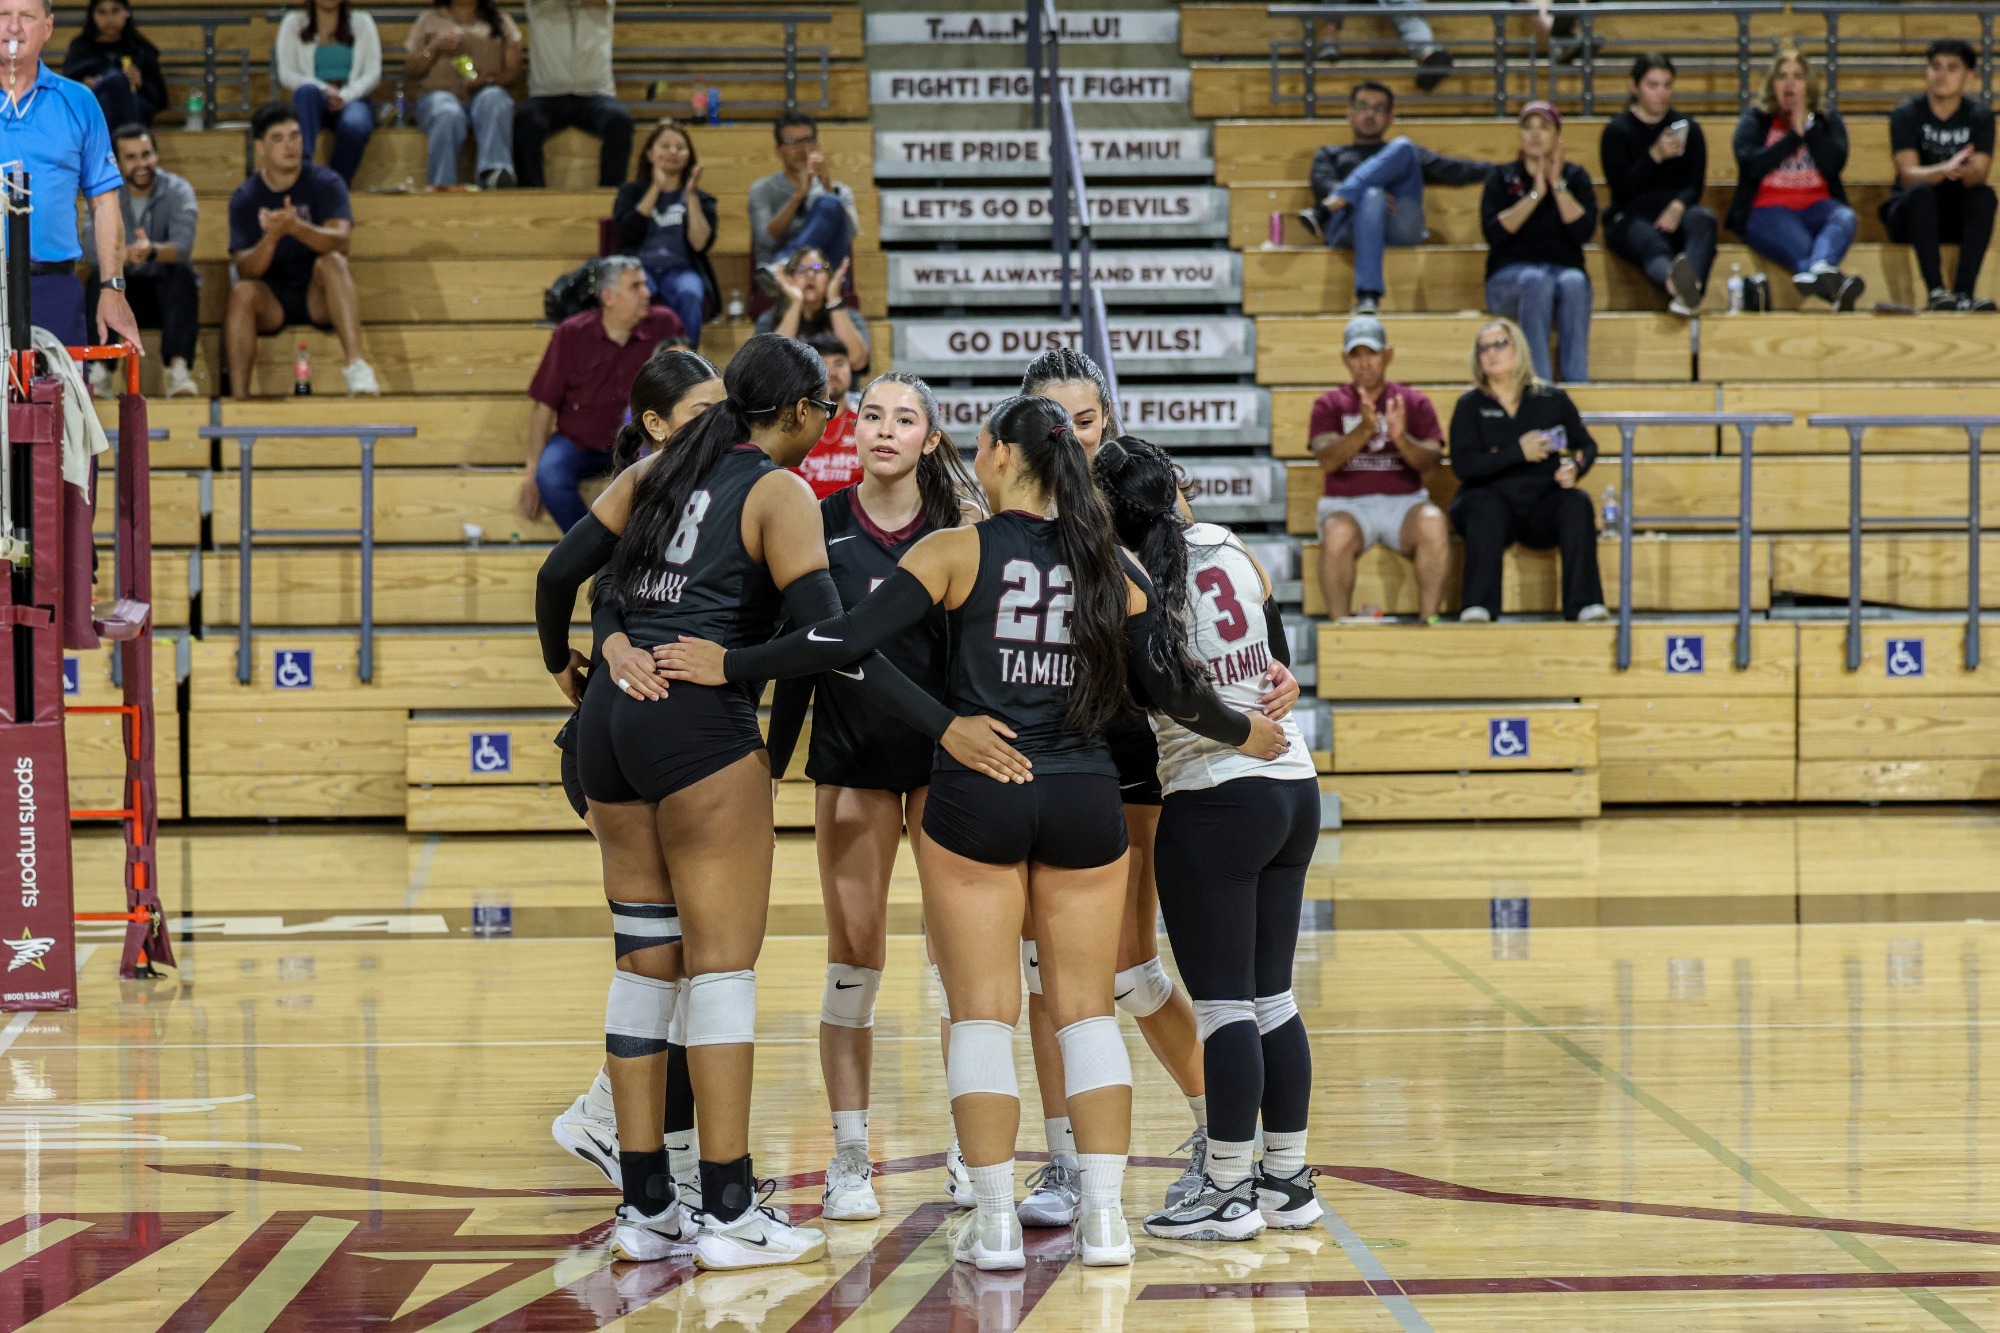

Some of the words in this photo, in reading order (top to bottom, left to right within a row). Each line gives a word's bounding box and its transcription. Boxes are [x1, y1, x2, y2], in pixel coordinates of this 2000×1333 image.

[892, 77, 979, 98] FIGHT!
[1083, 75, 1171, 96] FIGHT!
[903, 142, 955, 161] THE
[962, 142, 1038, 160] PRIDE
[1090, 140, 1180, 160] TAMIU!
[903, 199, 972, 218] LET'S
[983, 199, 1018, 218] GO
[914, 268, 974, 284] WE'LL
[1142, 266, 1165, 283] BY
[1173, 266, 1213, 283] YOU
[949, 331, 991, 353] GO
[1003, 329, 1201, 352] DUSTEVILS!
[1140, 400, 1236, 423] FIGHT!
[664, 489, 713, 567] 8
[1194, 566, 1249, 645] 3
[1208, 640, 1269, 687] TAMIU
[14, 757, 37, 825] sports
[17, 826, 40, 908] imports
[4, 992, 24, 1002] (800)
